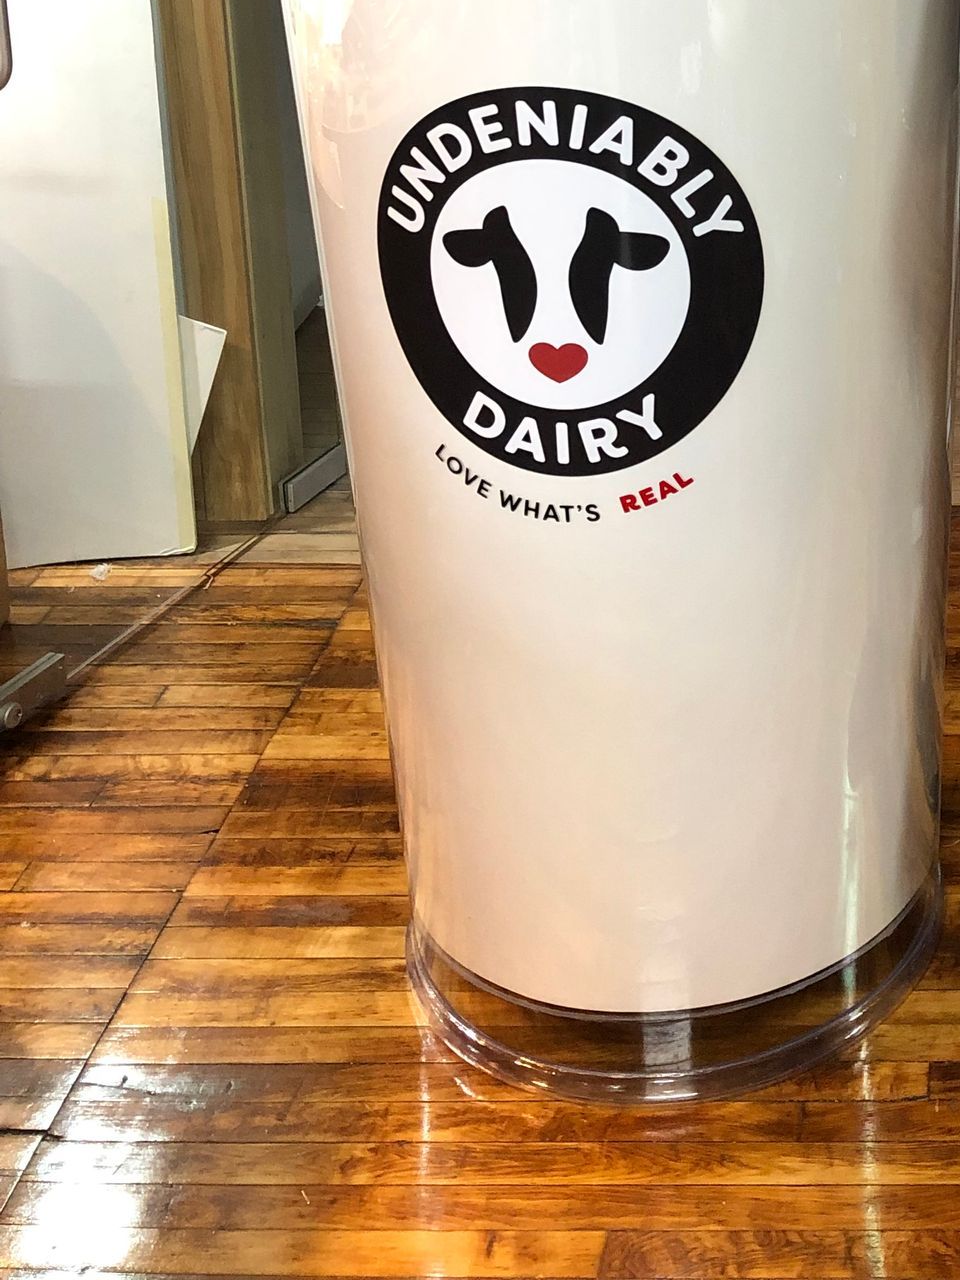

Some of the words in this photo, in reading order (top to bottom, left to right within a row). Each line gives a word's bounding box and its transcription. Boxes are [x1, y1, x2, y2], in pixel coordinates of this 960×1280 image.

[386, 100, 745, 238] UNDENIABLY
[462, 391, 664, 465] DAIRY
[434, 443, 493, 499] LOVE
[499, 488, 601, 524] WHAT'S
[619, 472, 695, 514] REAL
